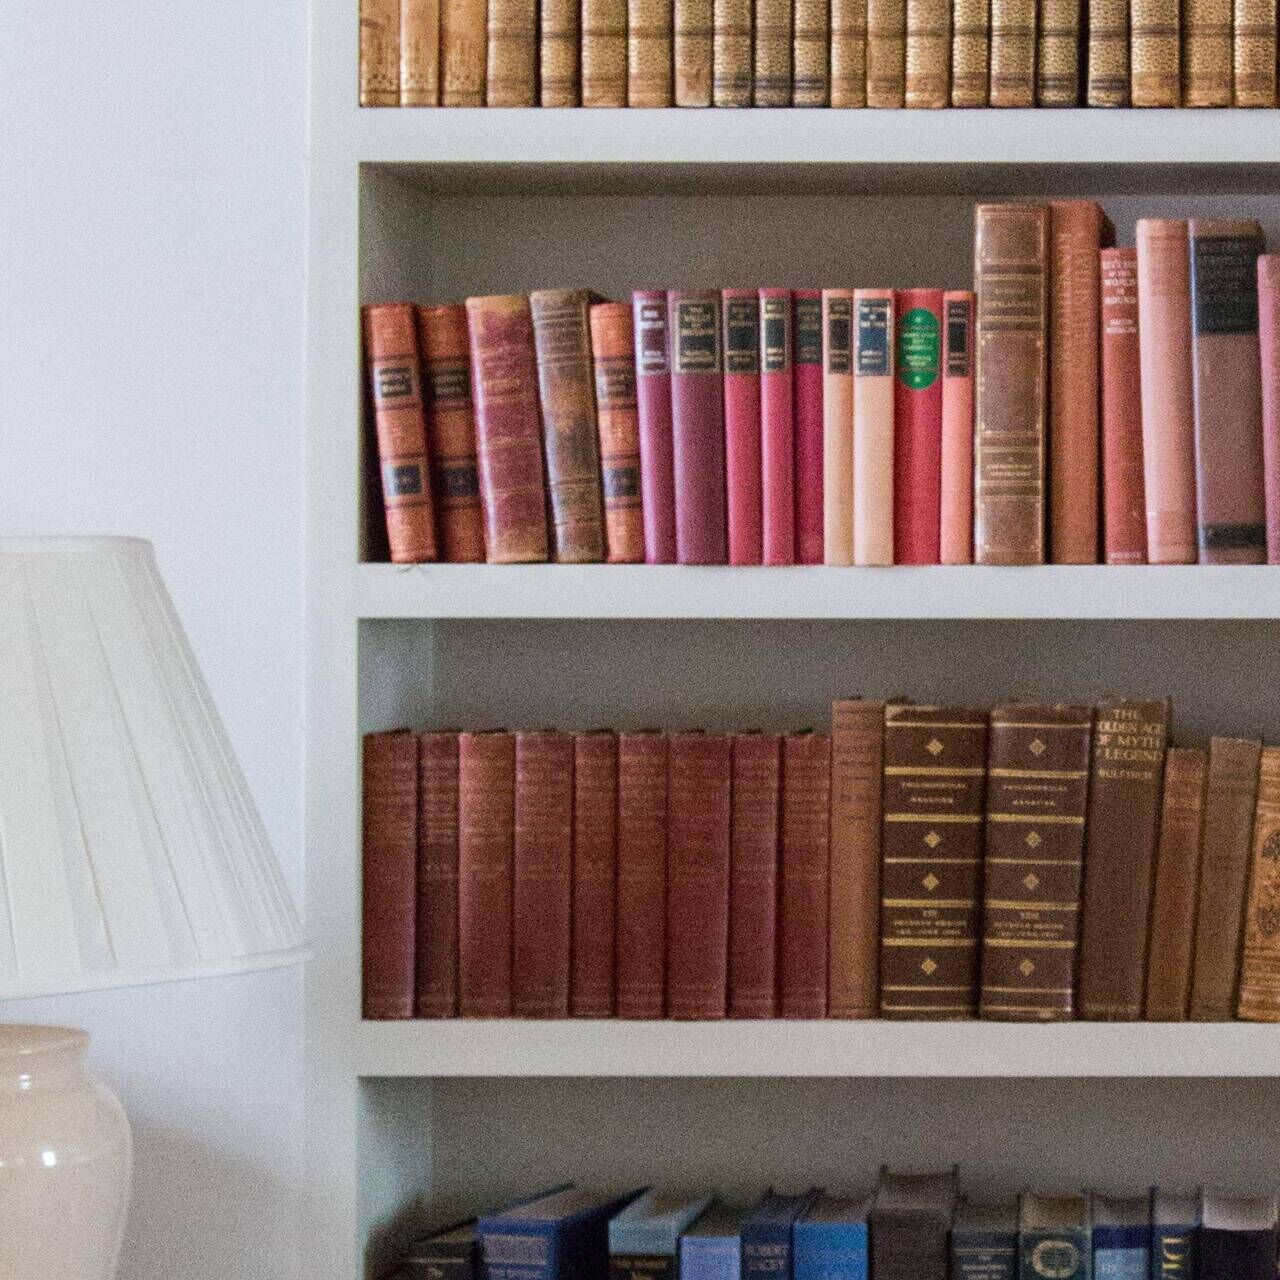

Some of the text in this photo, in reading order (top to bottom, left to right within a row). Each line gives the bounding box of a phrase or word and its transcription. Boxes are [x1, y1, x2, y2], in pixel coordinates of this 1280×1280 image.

[1097, 721, 1139, 734] OLDEN
[1117, 735, 1161, 749] MYTH
[1105, 748, 1165, 762] LEGEND
